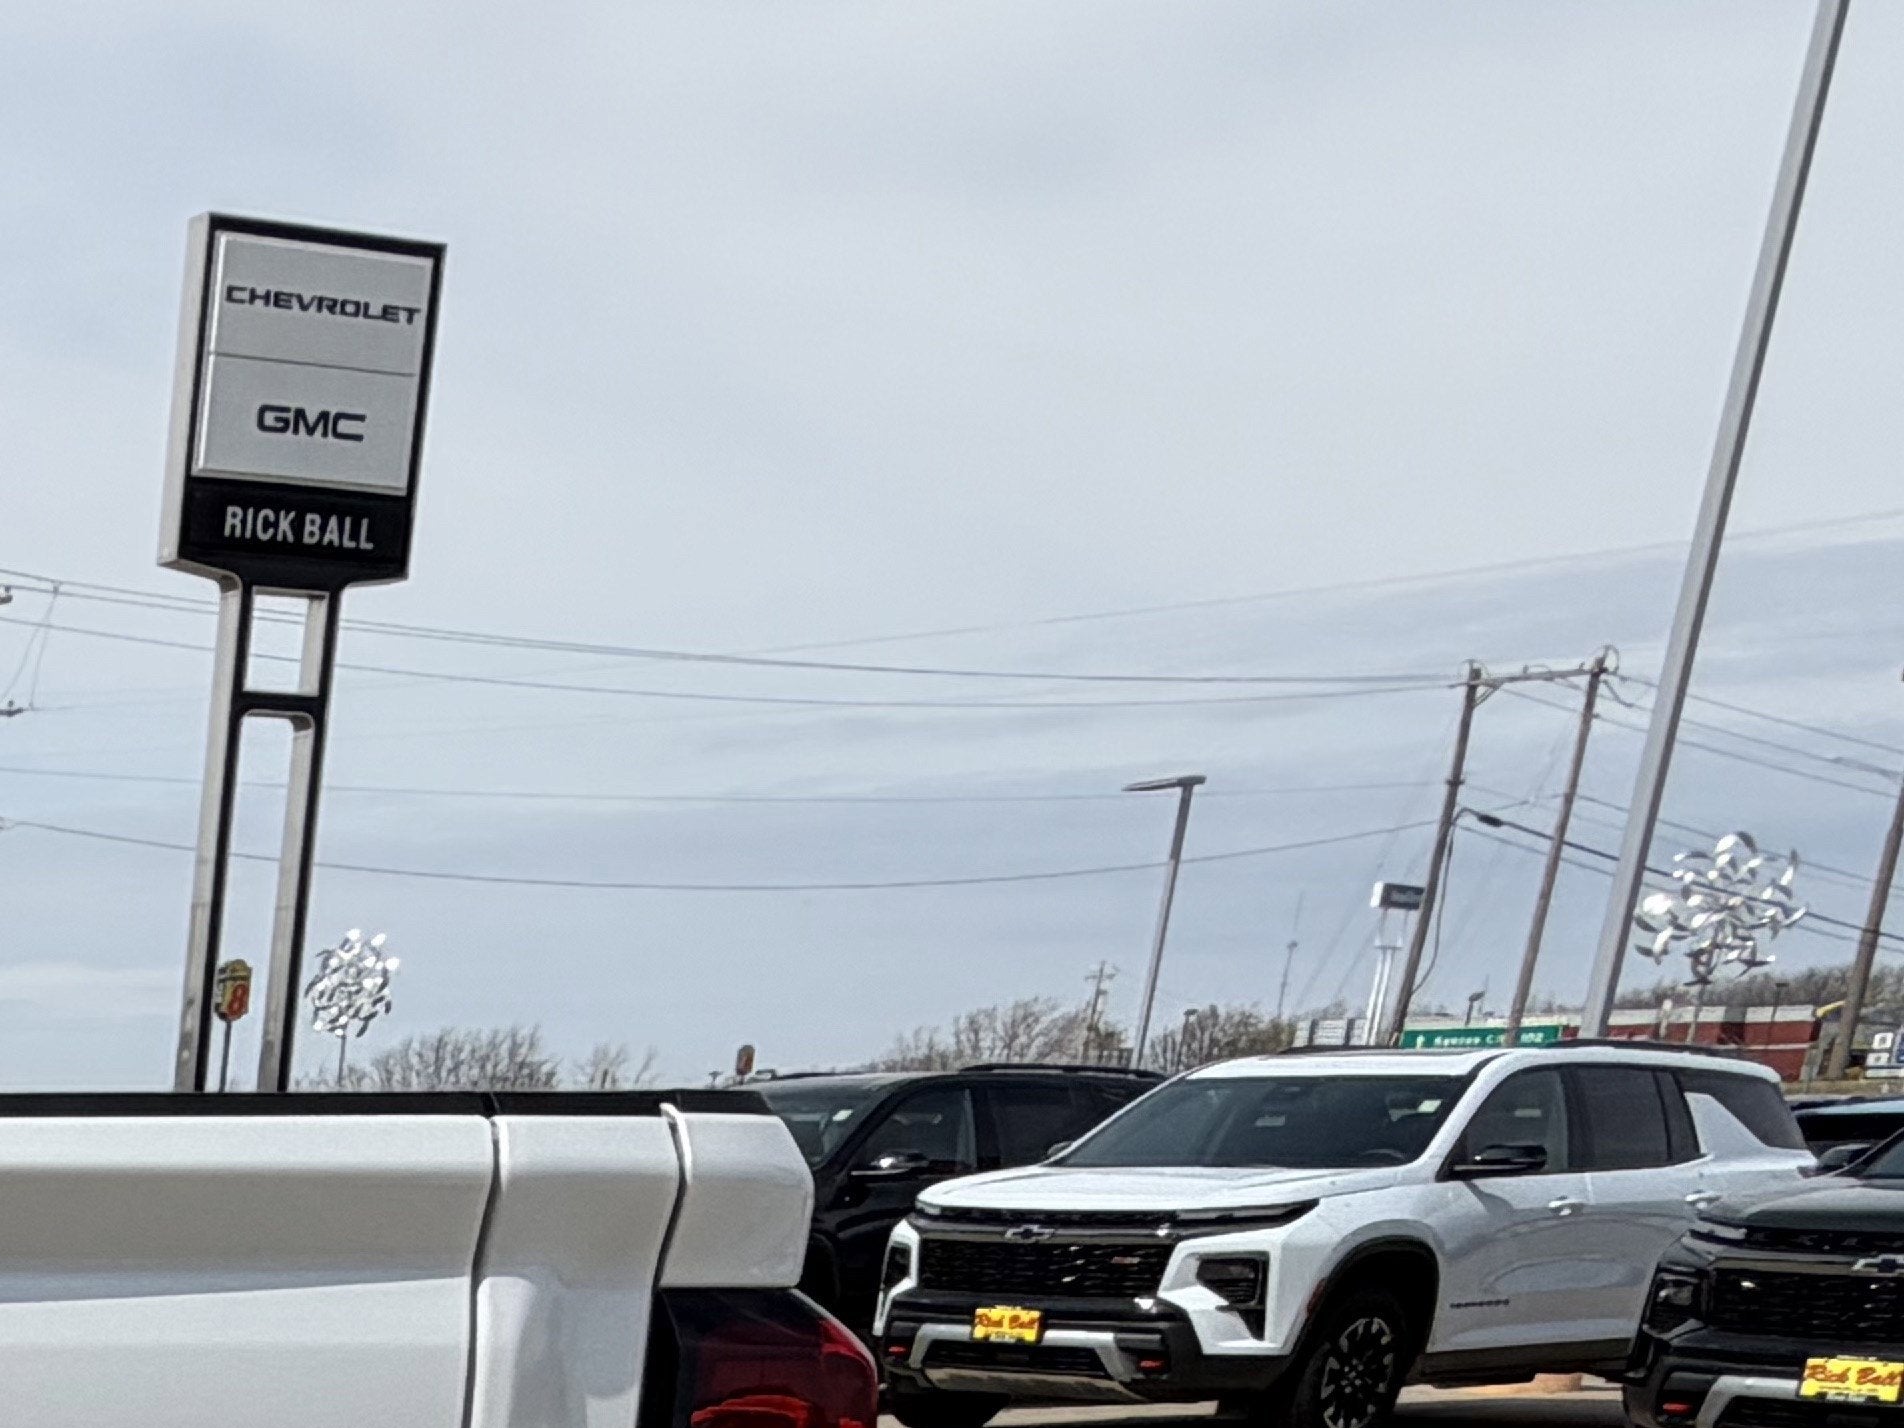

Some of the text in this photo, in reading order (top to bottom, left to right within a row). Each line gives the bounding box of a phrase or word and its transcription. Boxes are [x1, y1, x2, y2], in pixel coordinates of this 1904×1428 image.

[225, 284, 421, 325] CHEVROLET
[256, 404, 367, 441] GMC
[223, 505, 374, 550] RICK BALL
